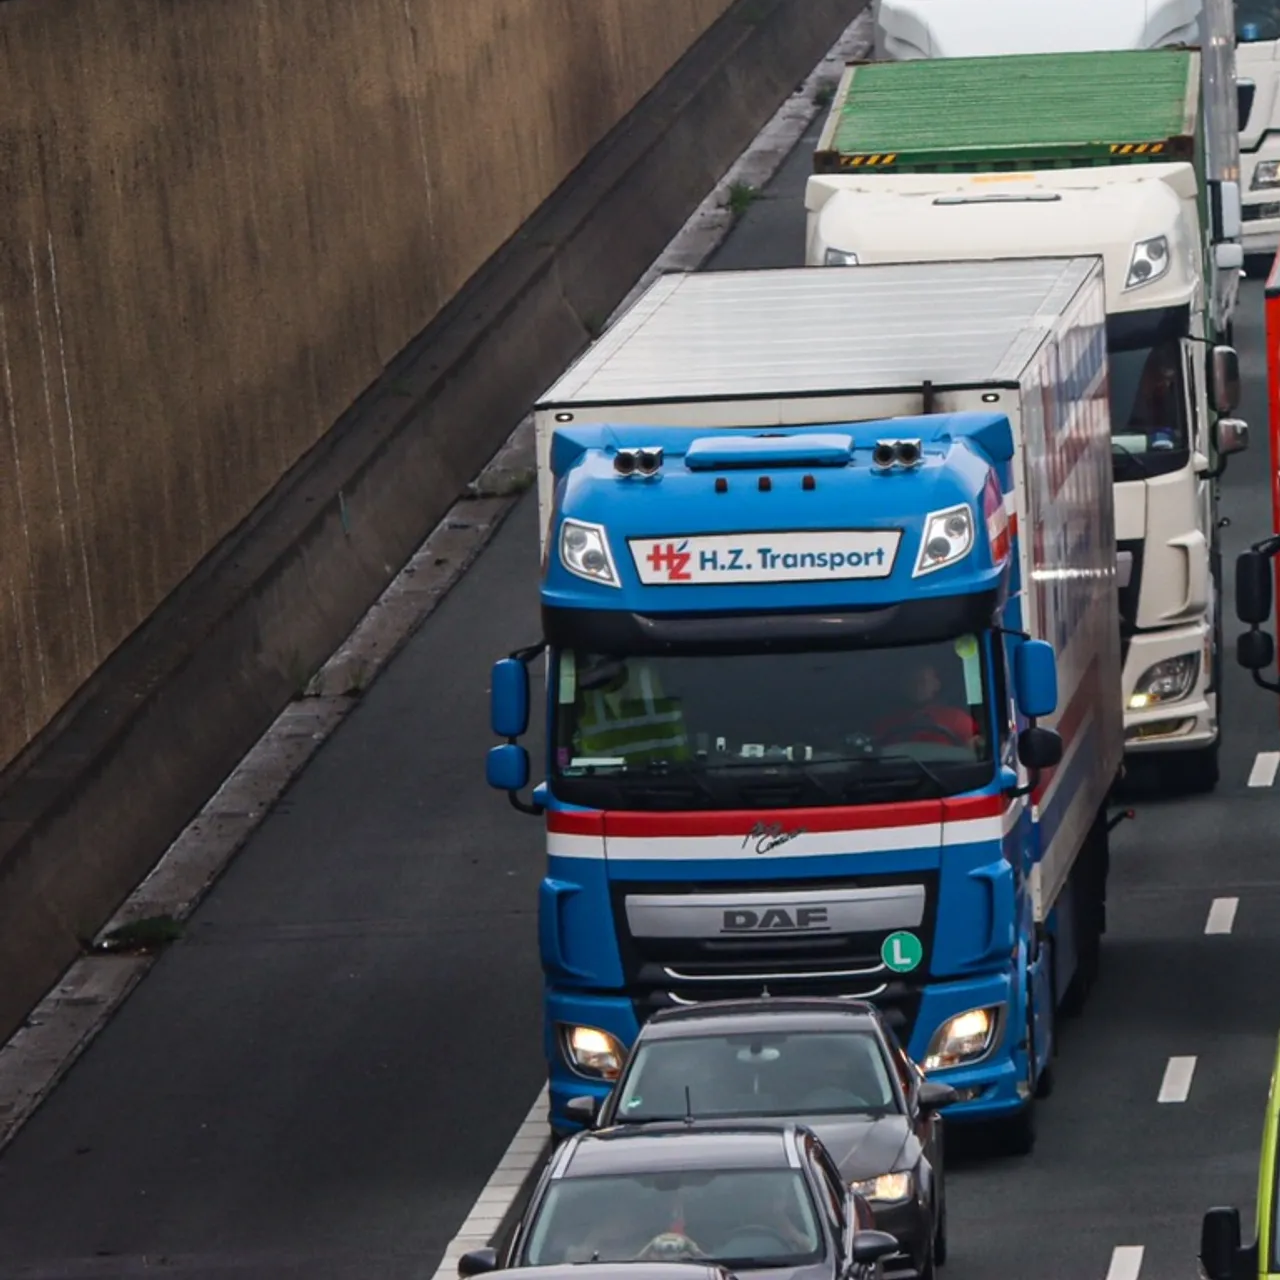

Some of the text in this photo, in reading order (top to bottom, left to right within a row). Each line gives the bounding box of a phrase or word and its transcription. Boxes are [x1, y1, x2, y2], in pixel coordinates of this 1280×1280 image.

[699, 548, 751, 571] H.Z.
[757, 547, 885, 572] Transport
[723, 907, 828, 929] DAF
[892, 939, 912, 965] L
